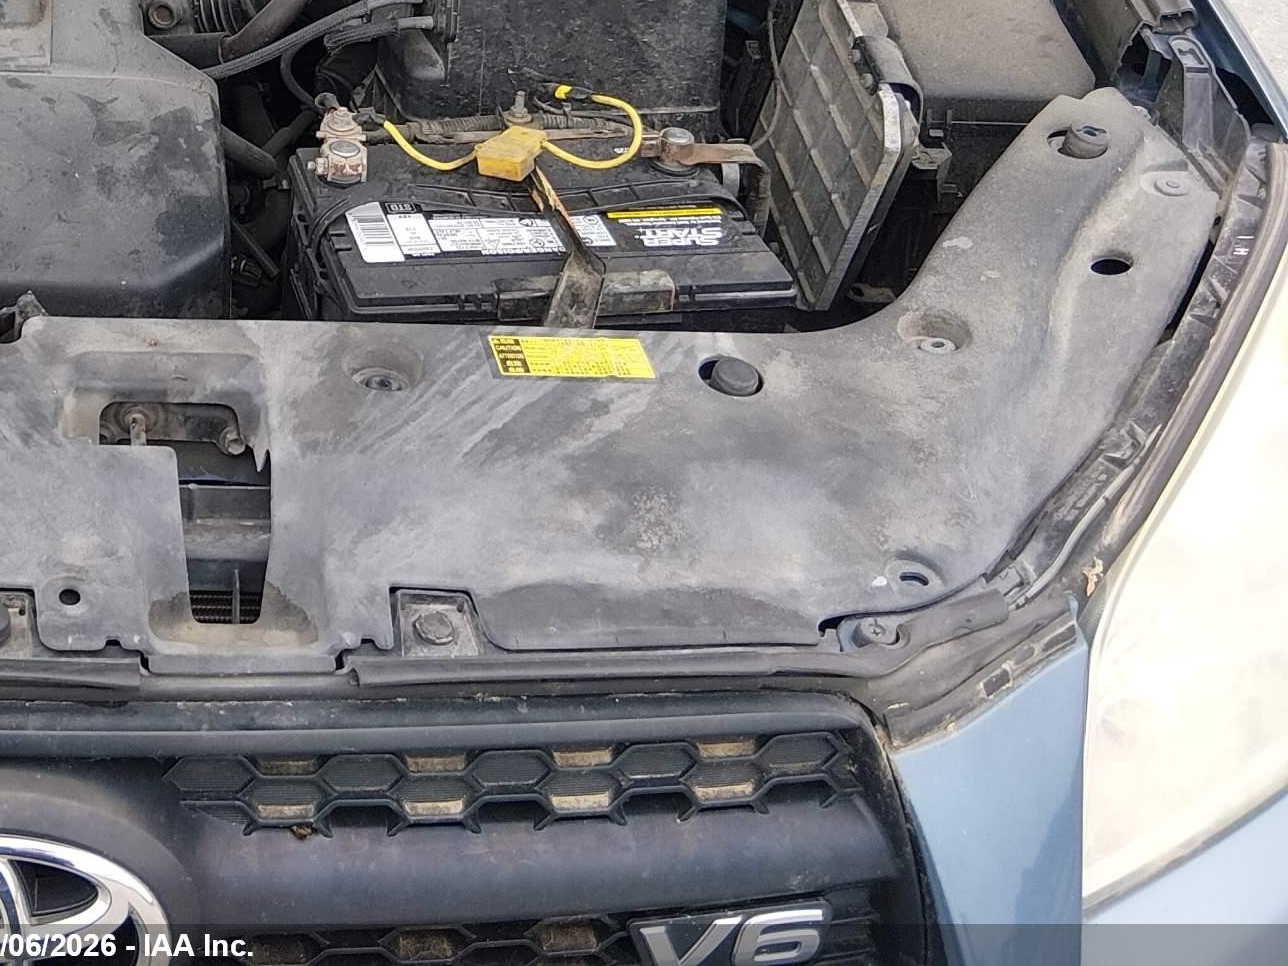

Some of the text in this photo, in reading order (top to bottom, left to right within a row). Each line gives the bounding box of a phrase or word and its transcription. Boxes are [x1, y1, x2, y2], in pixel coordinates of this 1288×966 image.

[643, 228, 721, 238] START
[644, 237, 720, 247] SUPER
[495, 344, 522, 352] CAUTION
[639, 908, 823, 966] V6
